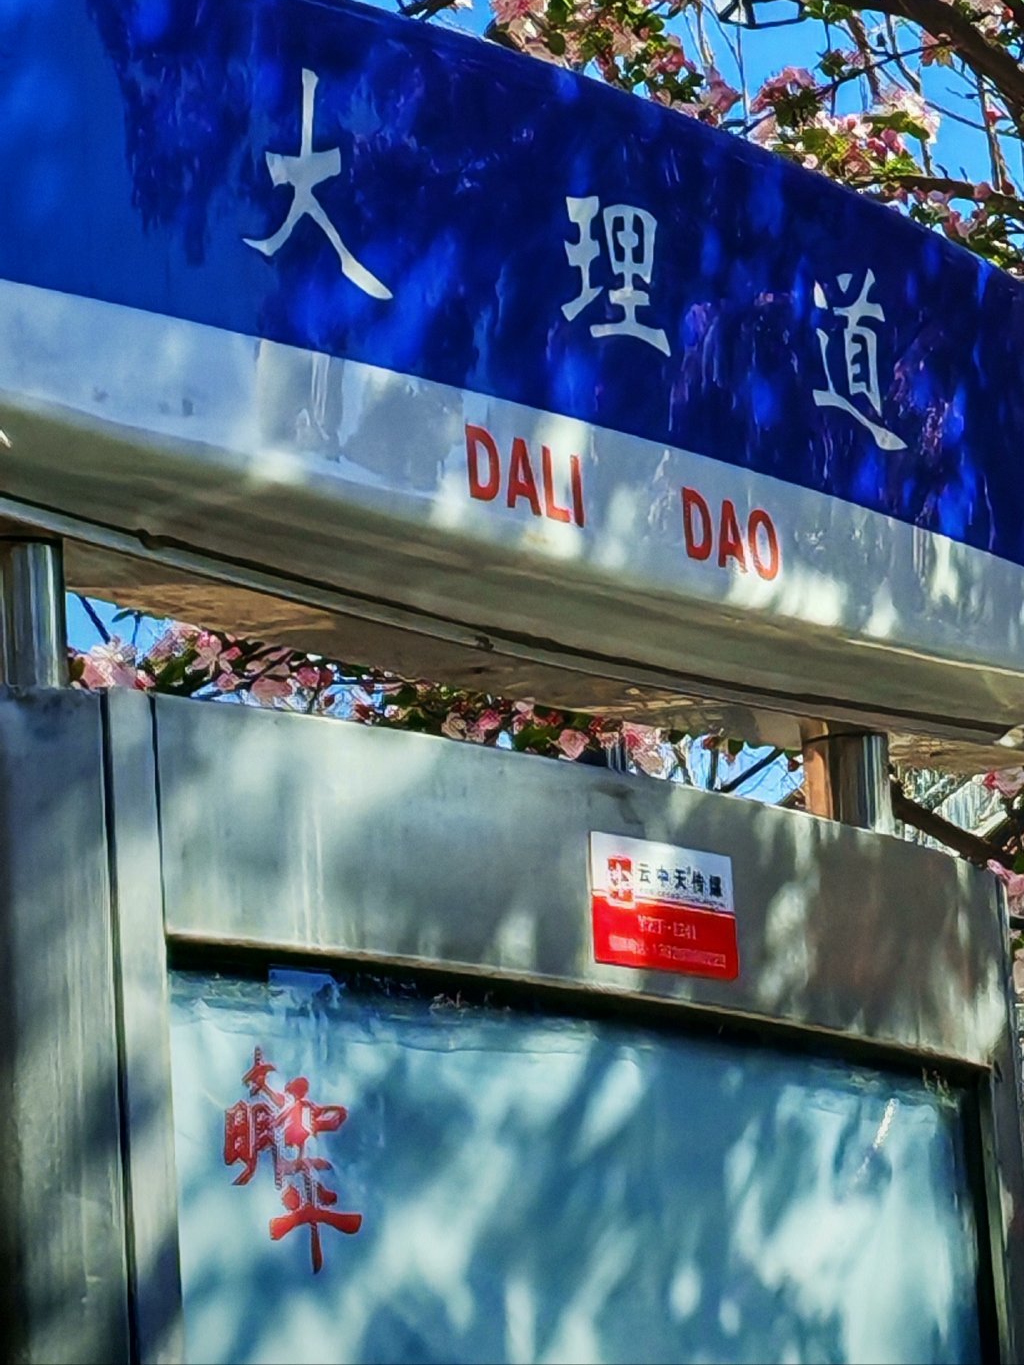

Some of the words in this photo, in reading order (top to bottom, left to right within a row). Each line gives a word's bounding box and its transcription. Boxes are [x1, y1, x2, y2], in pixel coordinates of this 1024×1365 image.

[242, 67, 908, 451] 大理道
[465, 423, 585, 528] DALI
[681, 486, 780, 581] DAO
